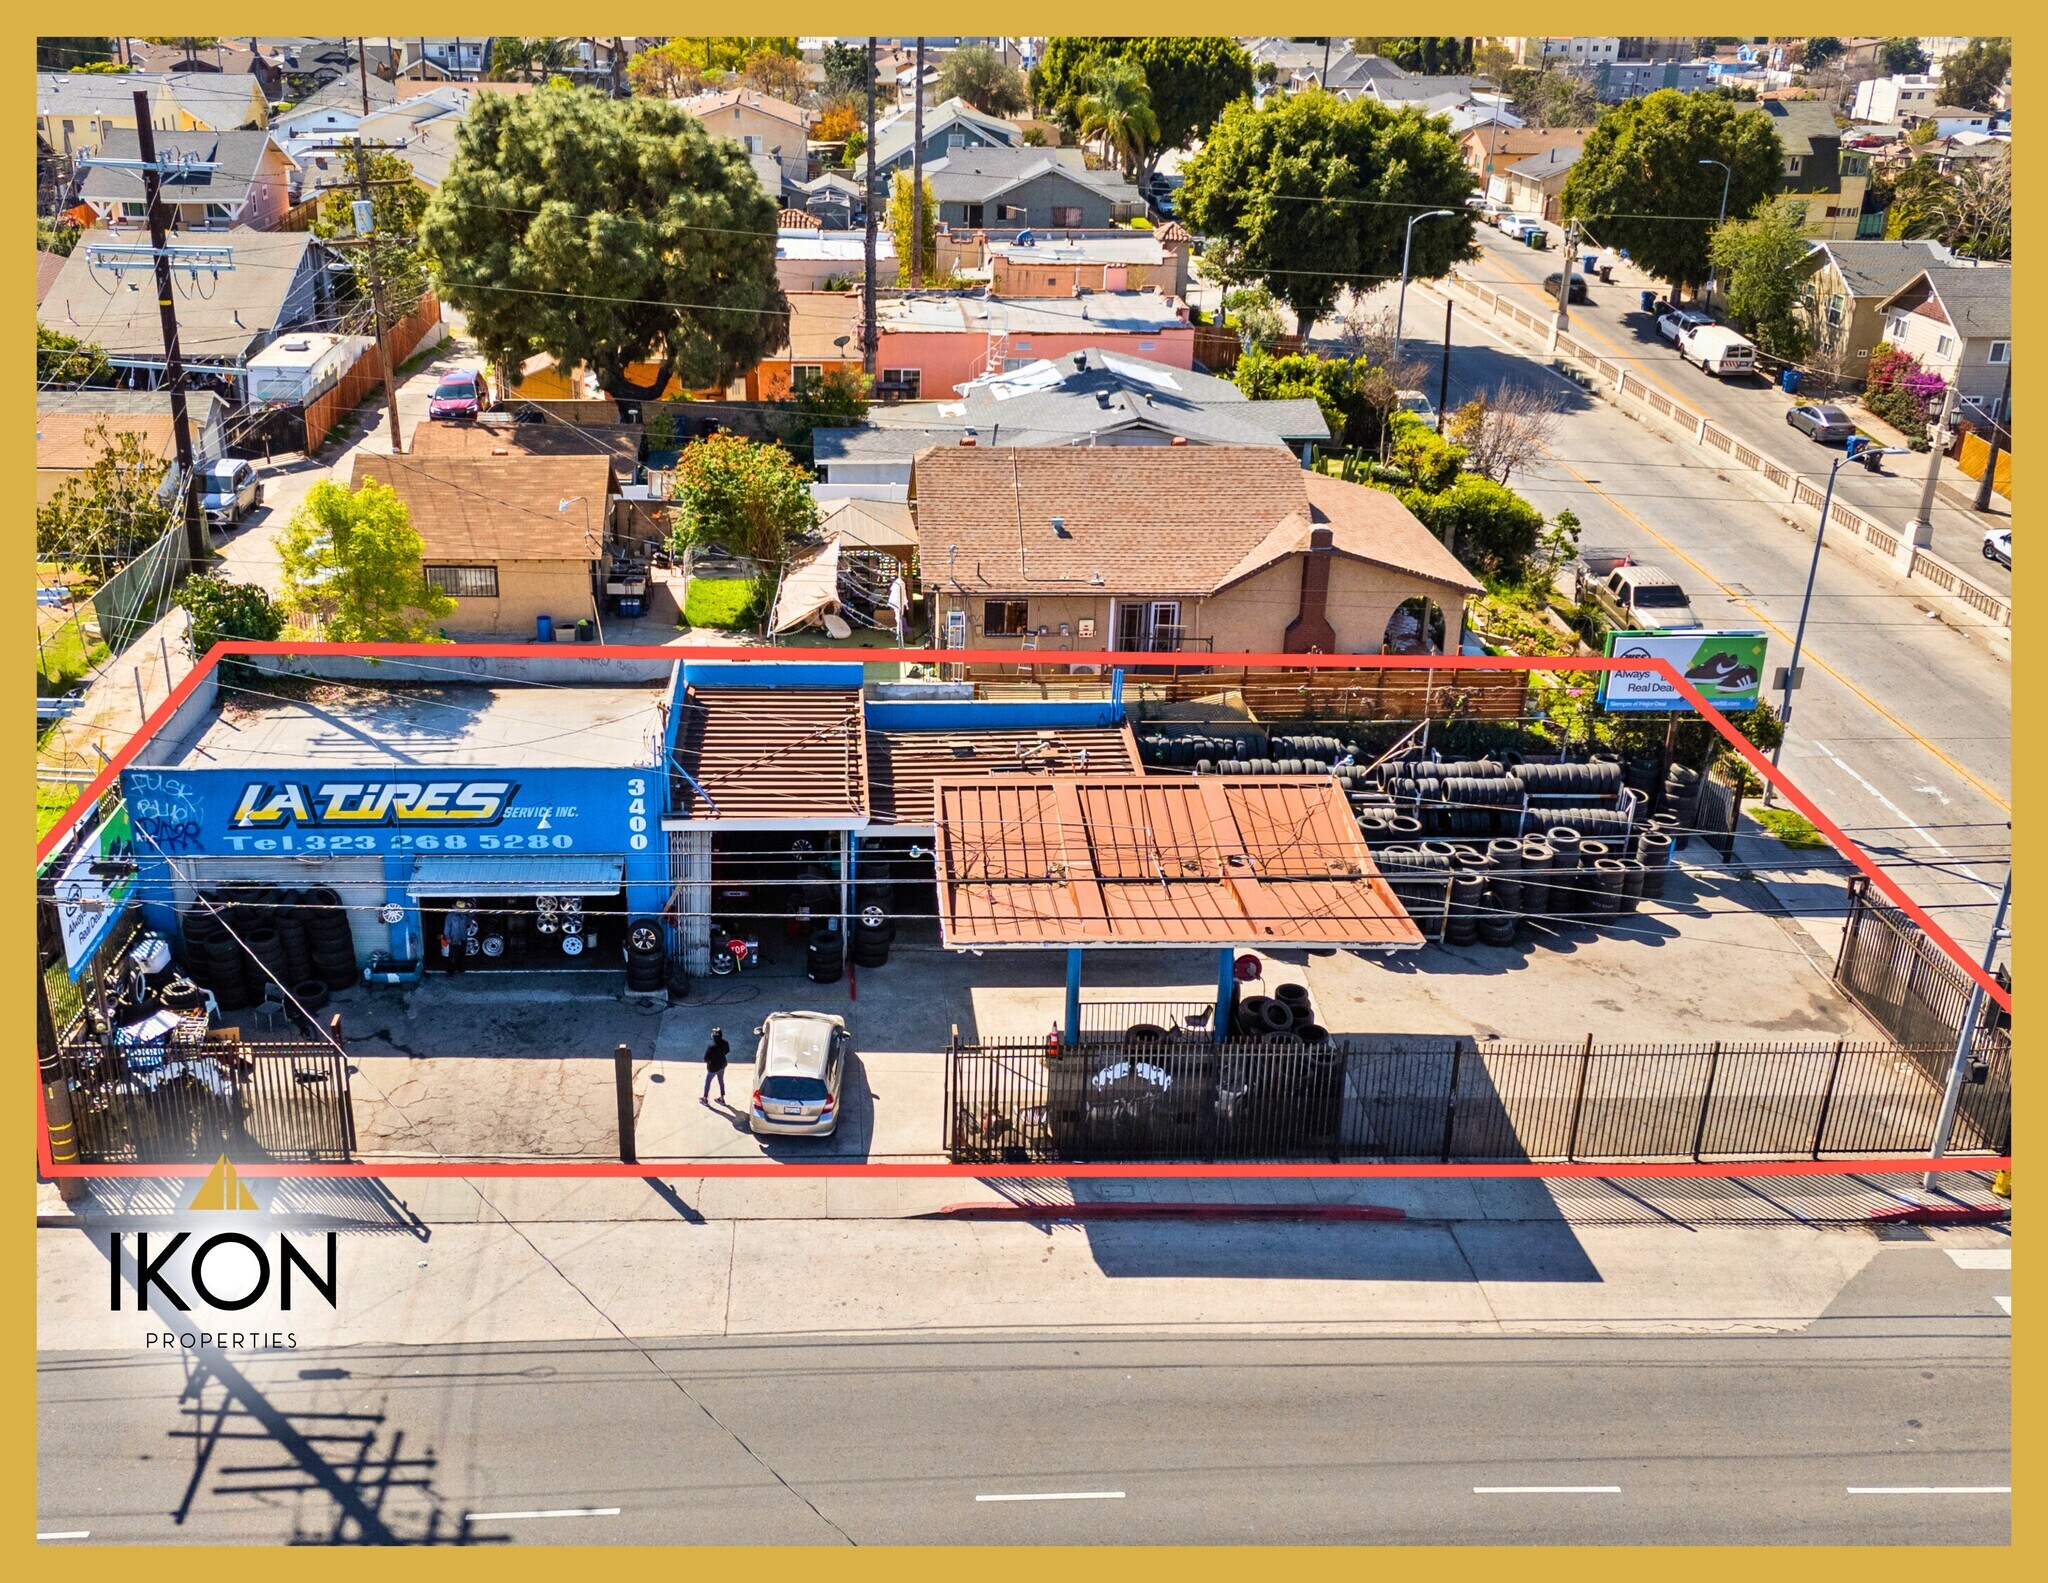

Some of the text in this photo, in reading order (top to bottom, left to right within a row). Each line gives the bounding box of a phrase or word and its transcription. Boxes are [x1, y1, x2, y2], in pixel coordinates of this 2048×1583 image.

[1614, 670, 1650, 680] Always
[1628, 683, 1651, 692] Real
[232, 783, 313, 825] LA
[503, 806, 579, 818] SERVICE INC.
[627, 778, 649, 850] 3400
[390, 835, 468, 850] 268
[479, 834, 573, 849] 5280
